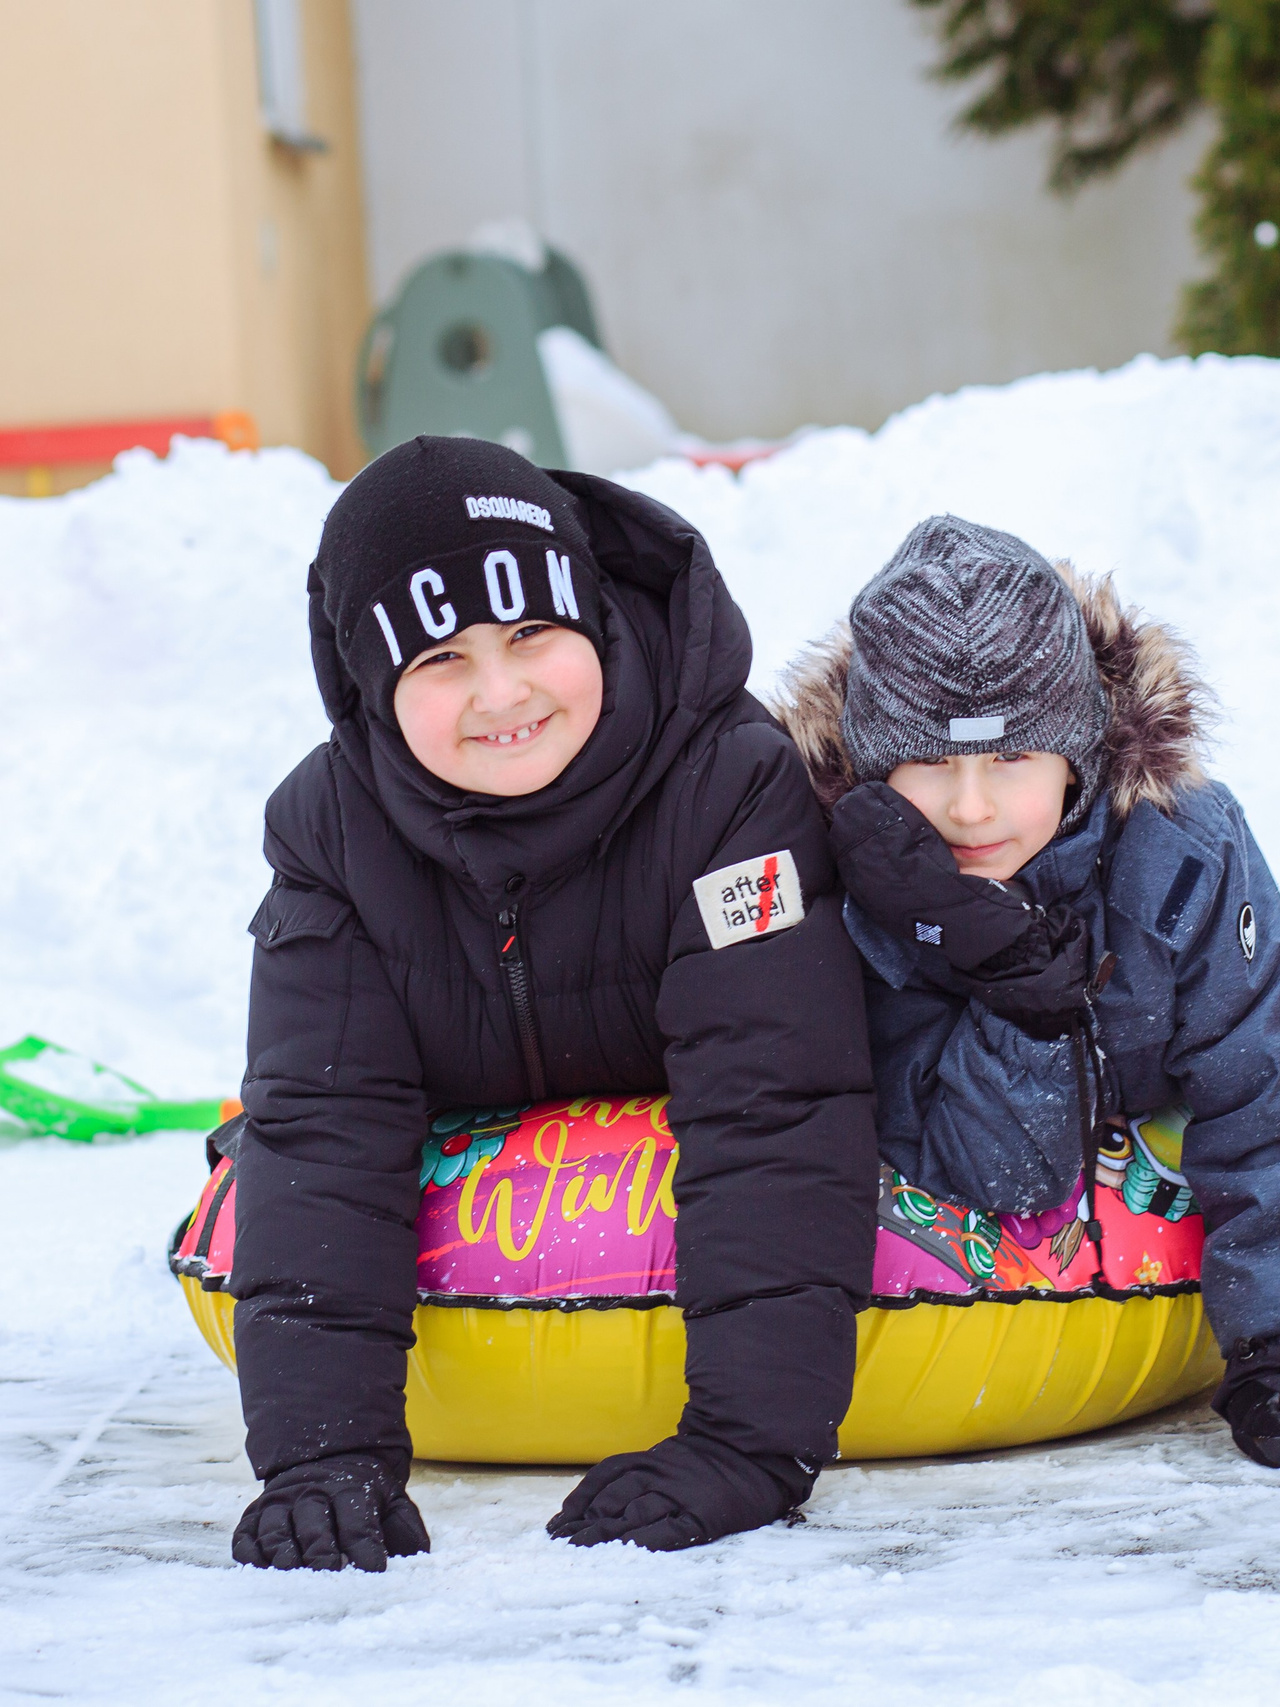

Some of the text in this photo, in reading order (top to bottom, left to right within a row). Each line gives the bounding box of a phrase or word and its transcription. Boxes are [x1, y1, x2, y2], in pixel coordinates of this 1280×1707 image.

[465, 497, 554, 532] DSQUARED2
[373, 549, 580, 666] ICON
[721, 873, 781, 904] after
[722, 892, 786, 930] label
